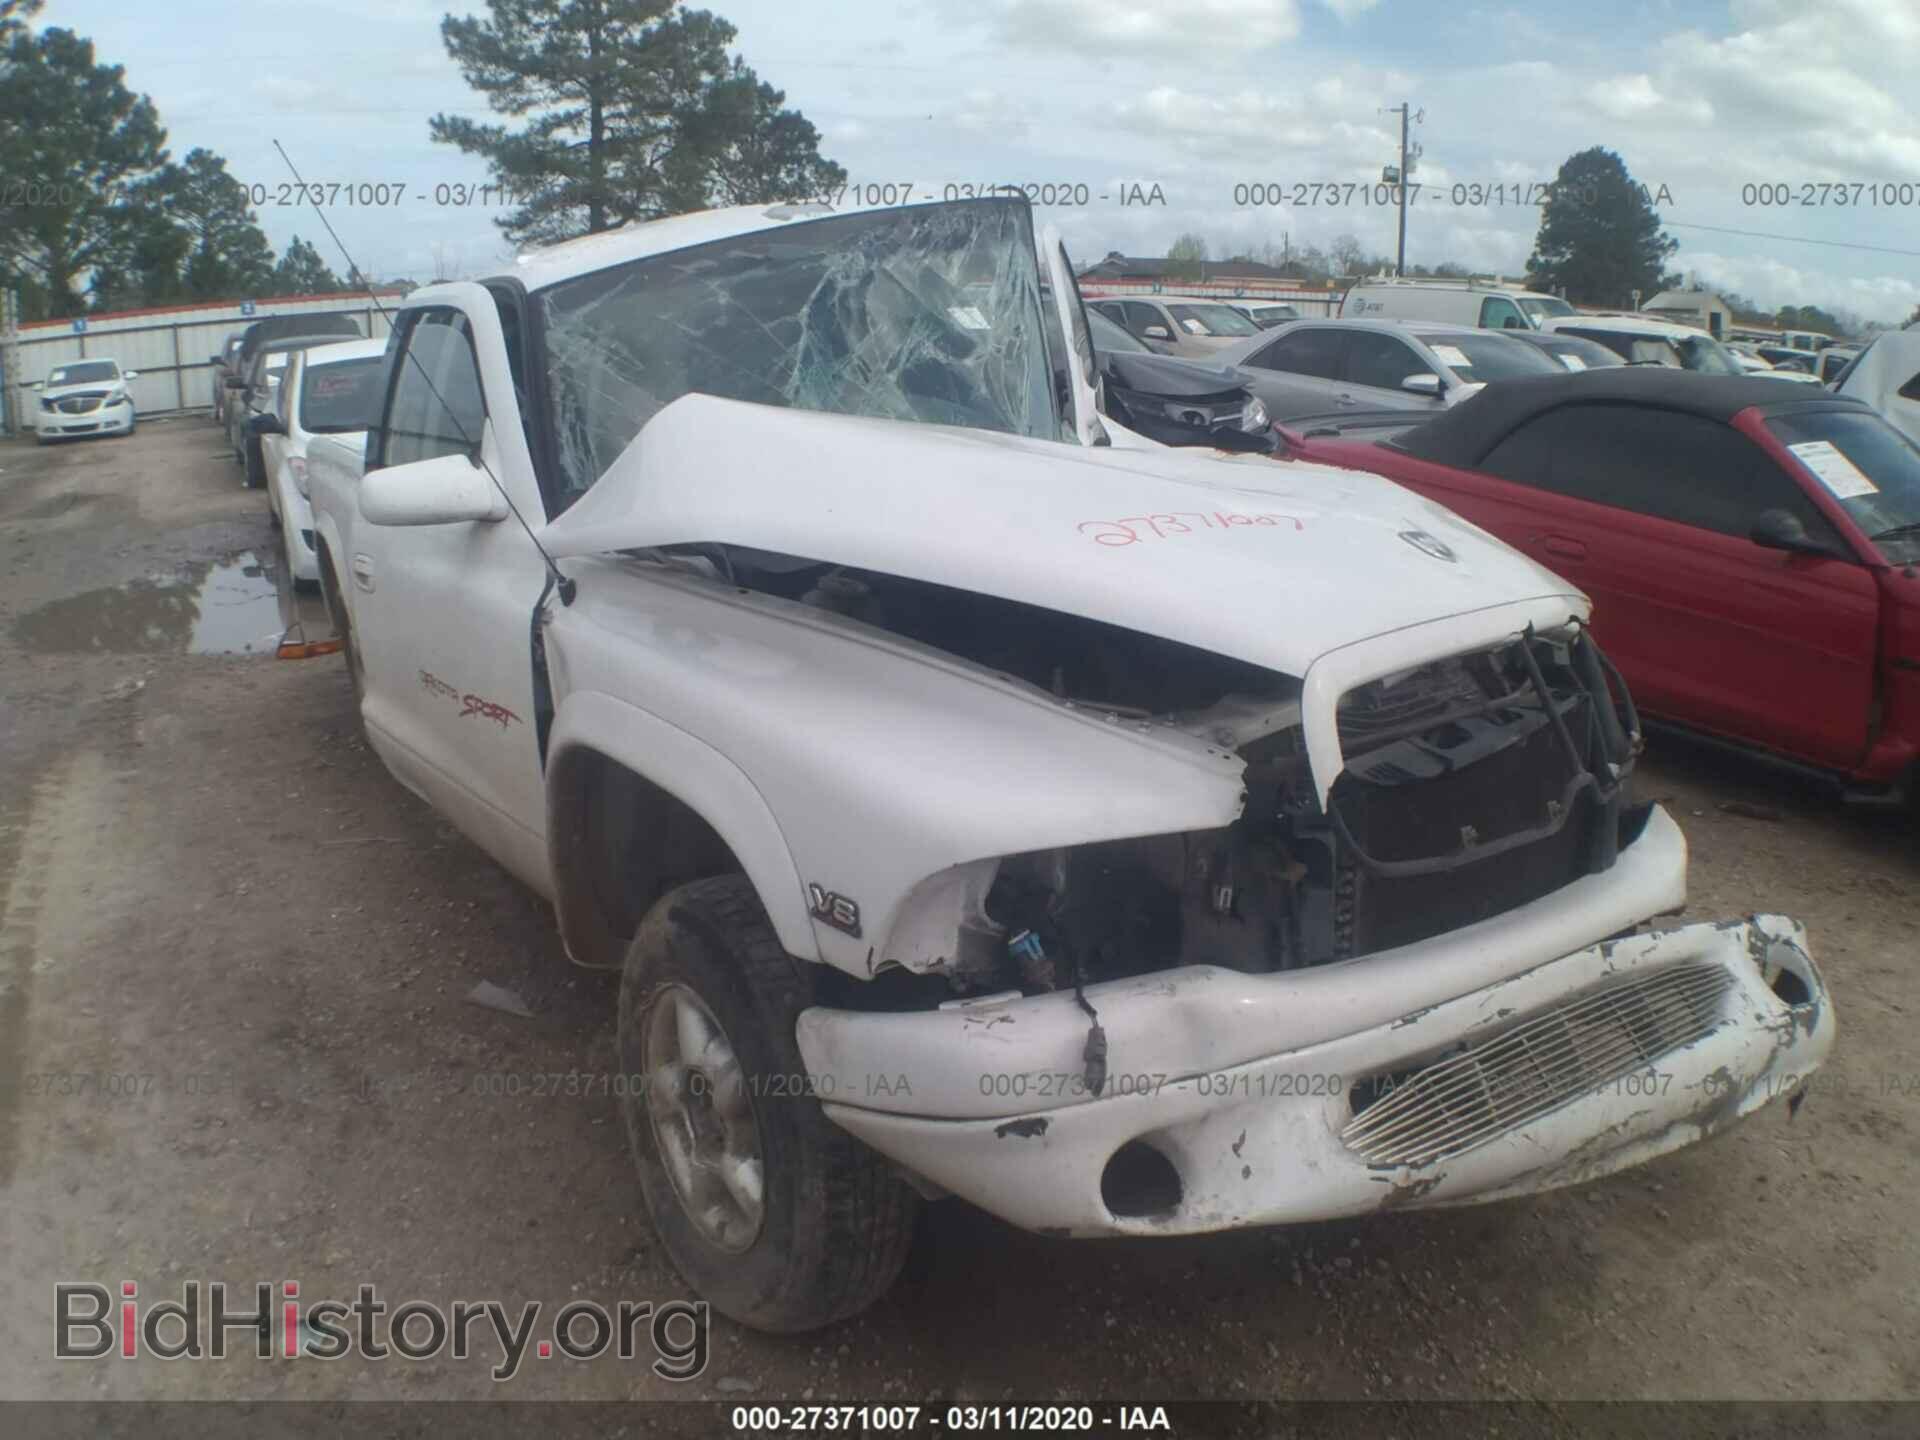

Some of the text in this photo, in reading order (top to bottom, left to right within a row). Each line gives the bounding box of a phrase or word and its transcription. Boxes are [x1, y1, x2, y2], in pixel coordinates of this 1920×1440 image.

[1077, 511, 1304, 547] 27371007
[459, 694, 524, 730] SPORT
[810, 884, 859, 928] V8
